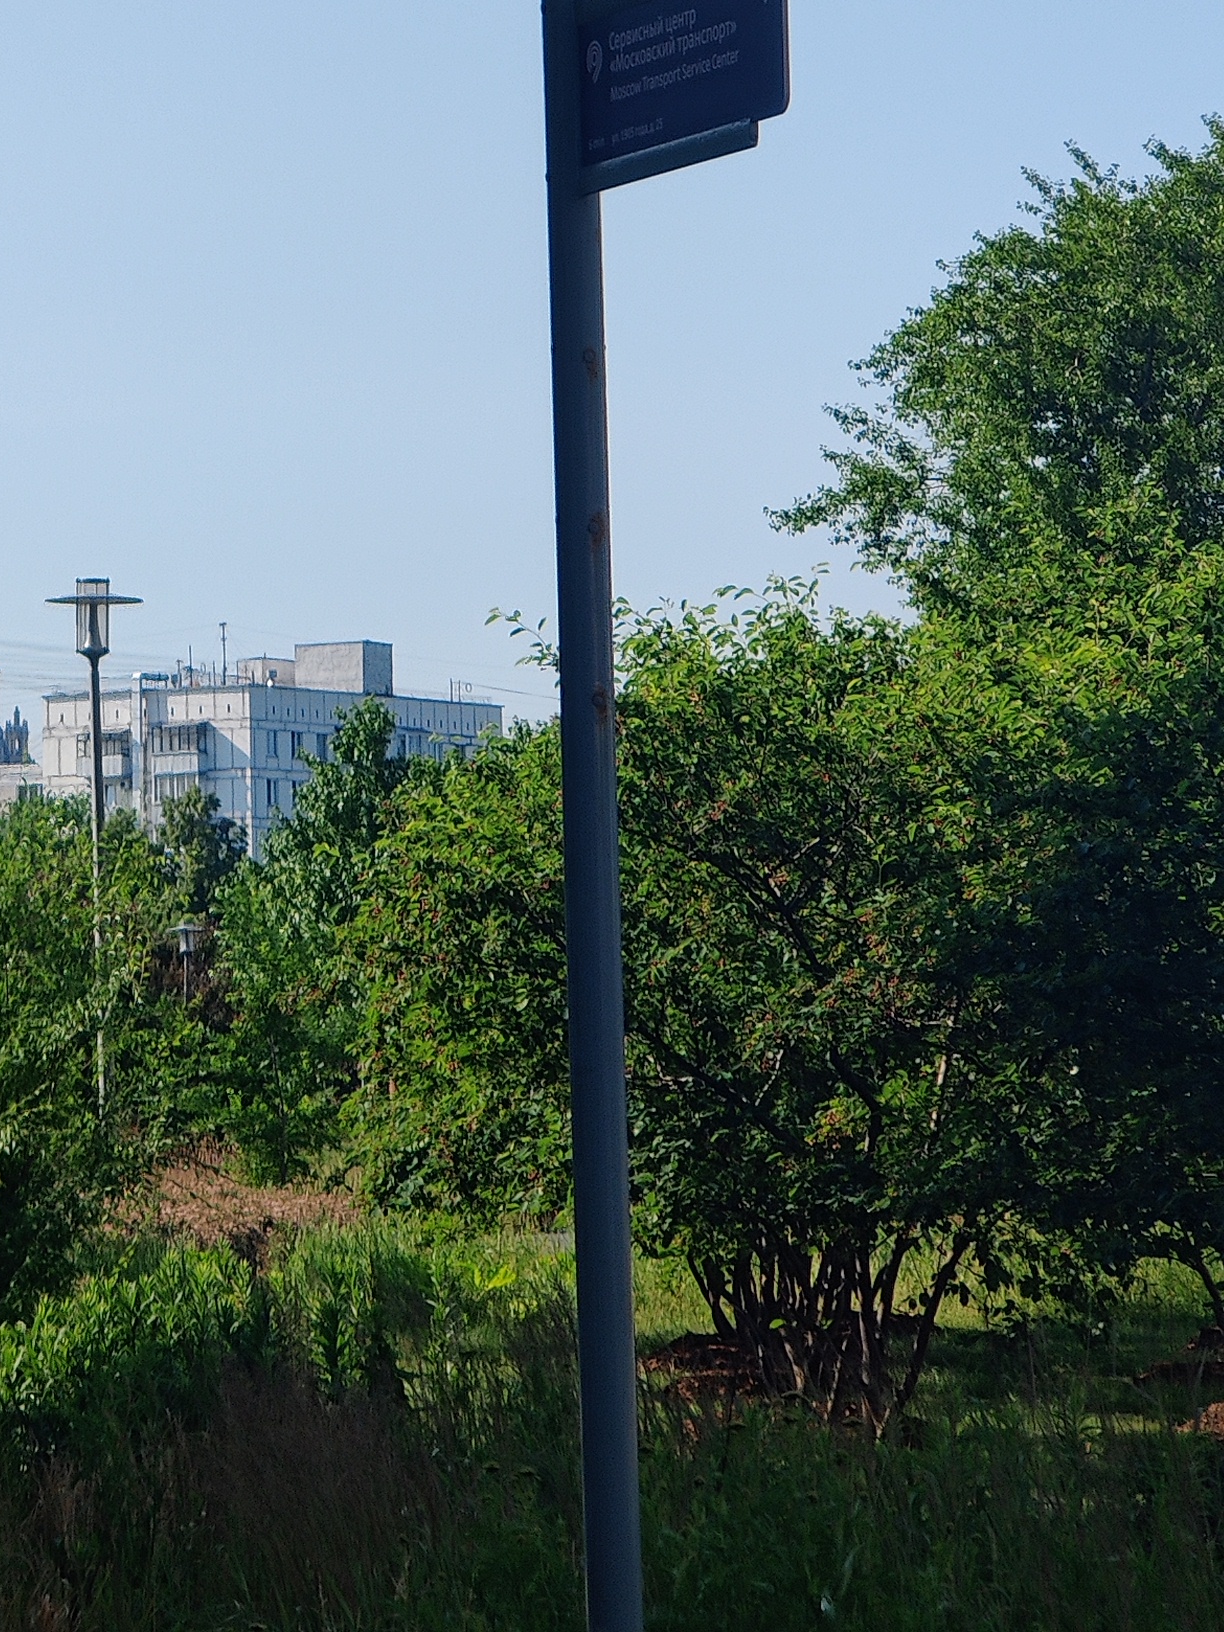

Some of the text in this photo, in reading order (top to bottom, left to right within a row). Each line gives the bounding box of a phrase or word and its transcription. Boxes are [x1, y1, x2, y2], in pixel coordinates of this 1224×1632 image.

[609, 8, 697, 52] Сервисный центр
[609, 48, 740, 101] Moscow Transport Service Center
